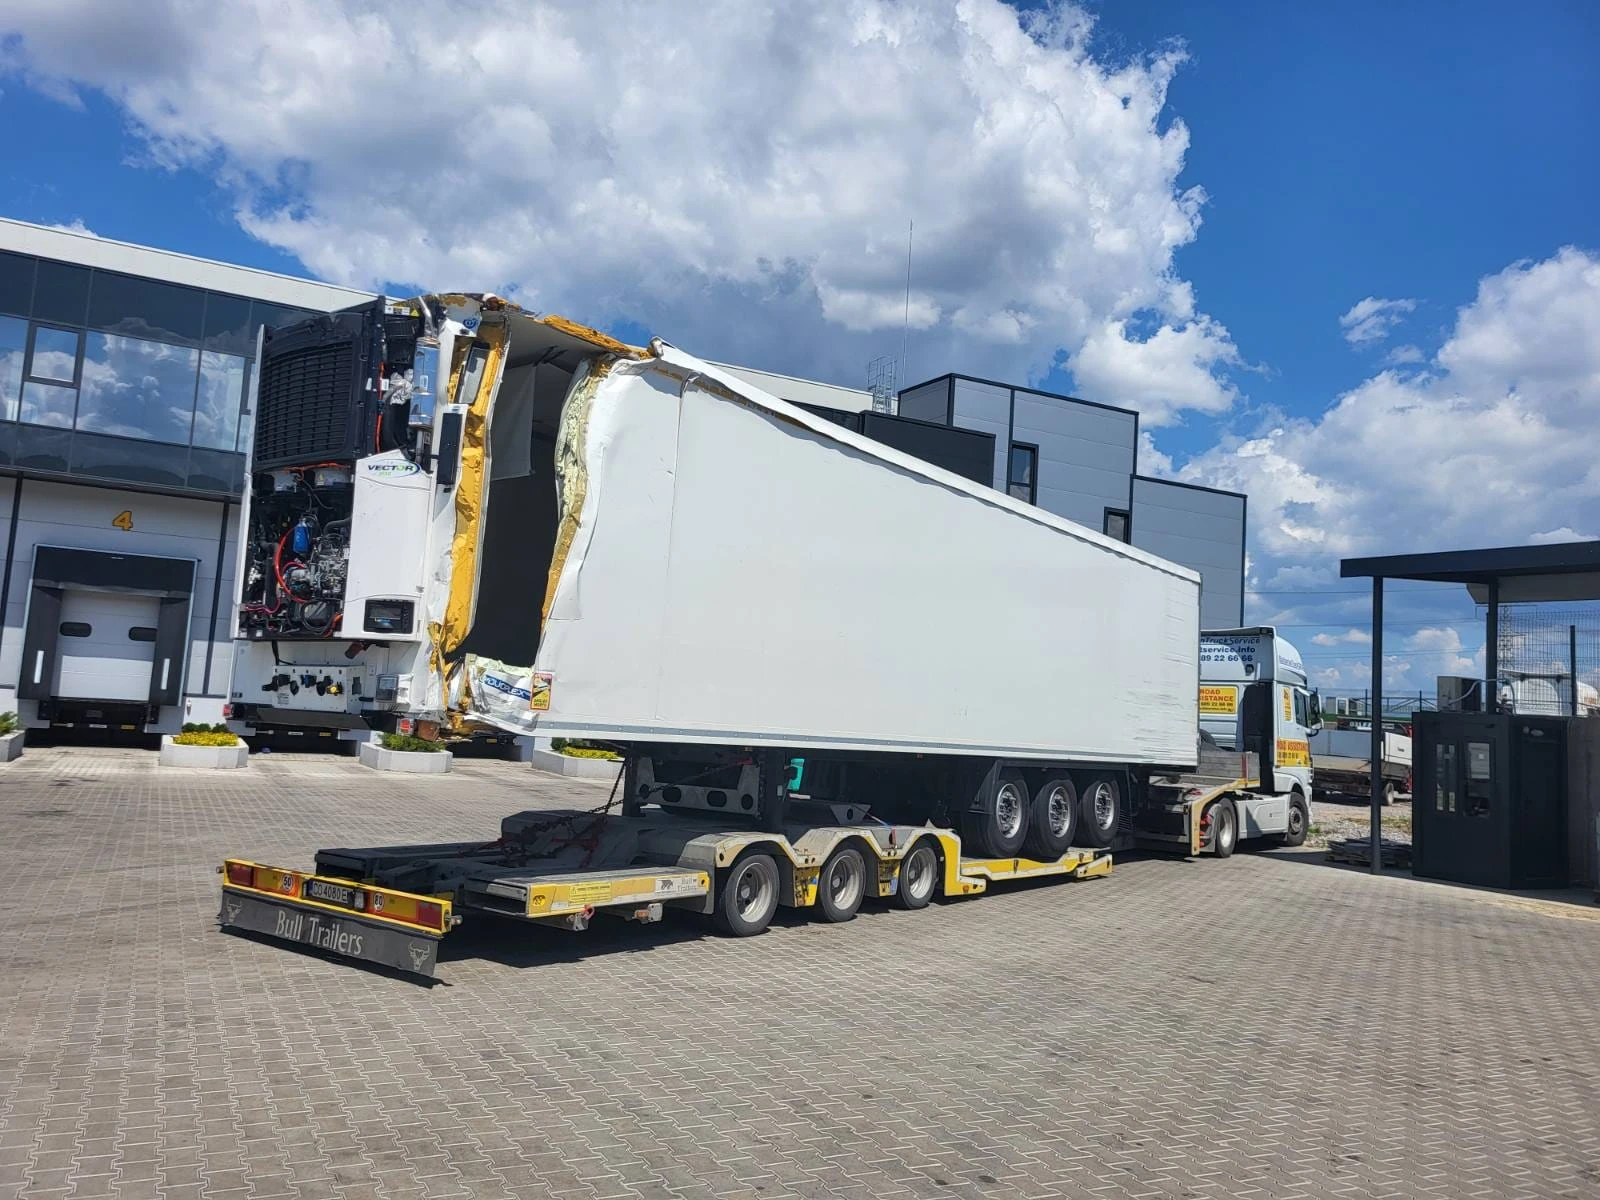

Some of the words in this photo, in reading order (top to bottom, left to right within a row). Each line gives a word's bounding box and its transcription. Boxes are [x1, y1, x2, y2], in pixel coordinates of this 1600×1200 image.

[112, 510, 133, 531] 4
[1214, 654, 1225, 662] 22
[1227, 654, 1239, 662] 66
[1241, 654, 1253, 662] 66
[284, 875, 292, 887] 50
[374, 895, 383, 906] 80
[275, 910, 303, 940] Bull
[308, 917, 364, 955] Trailers
